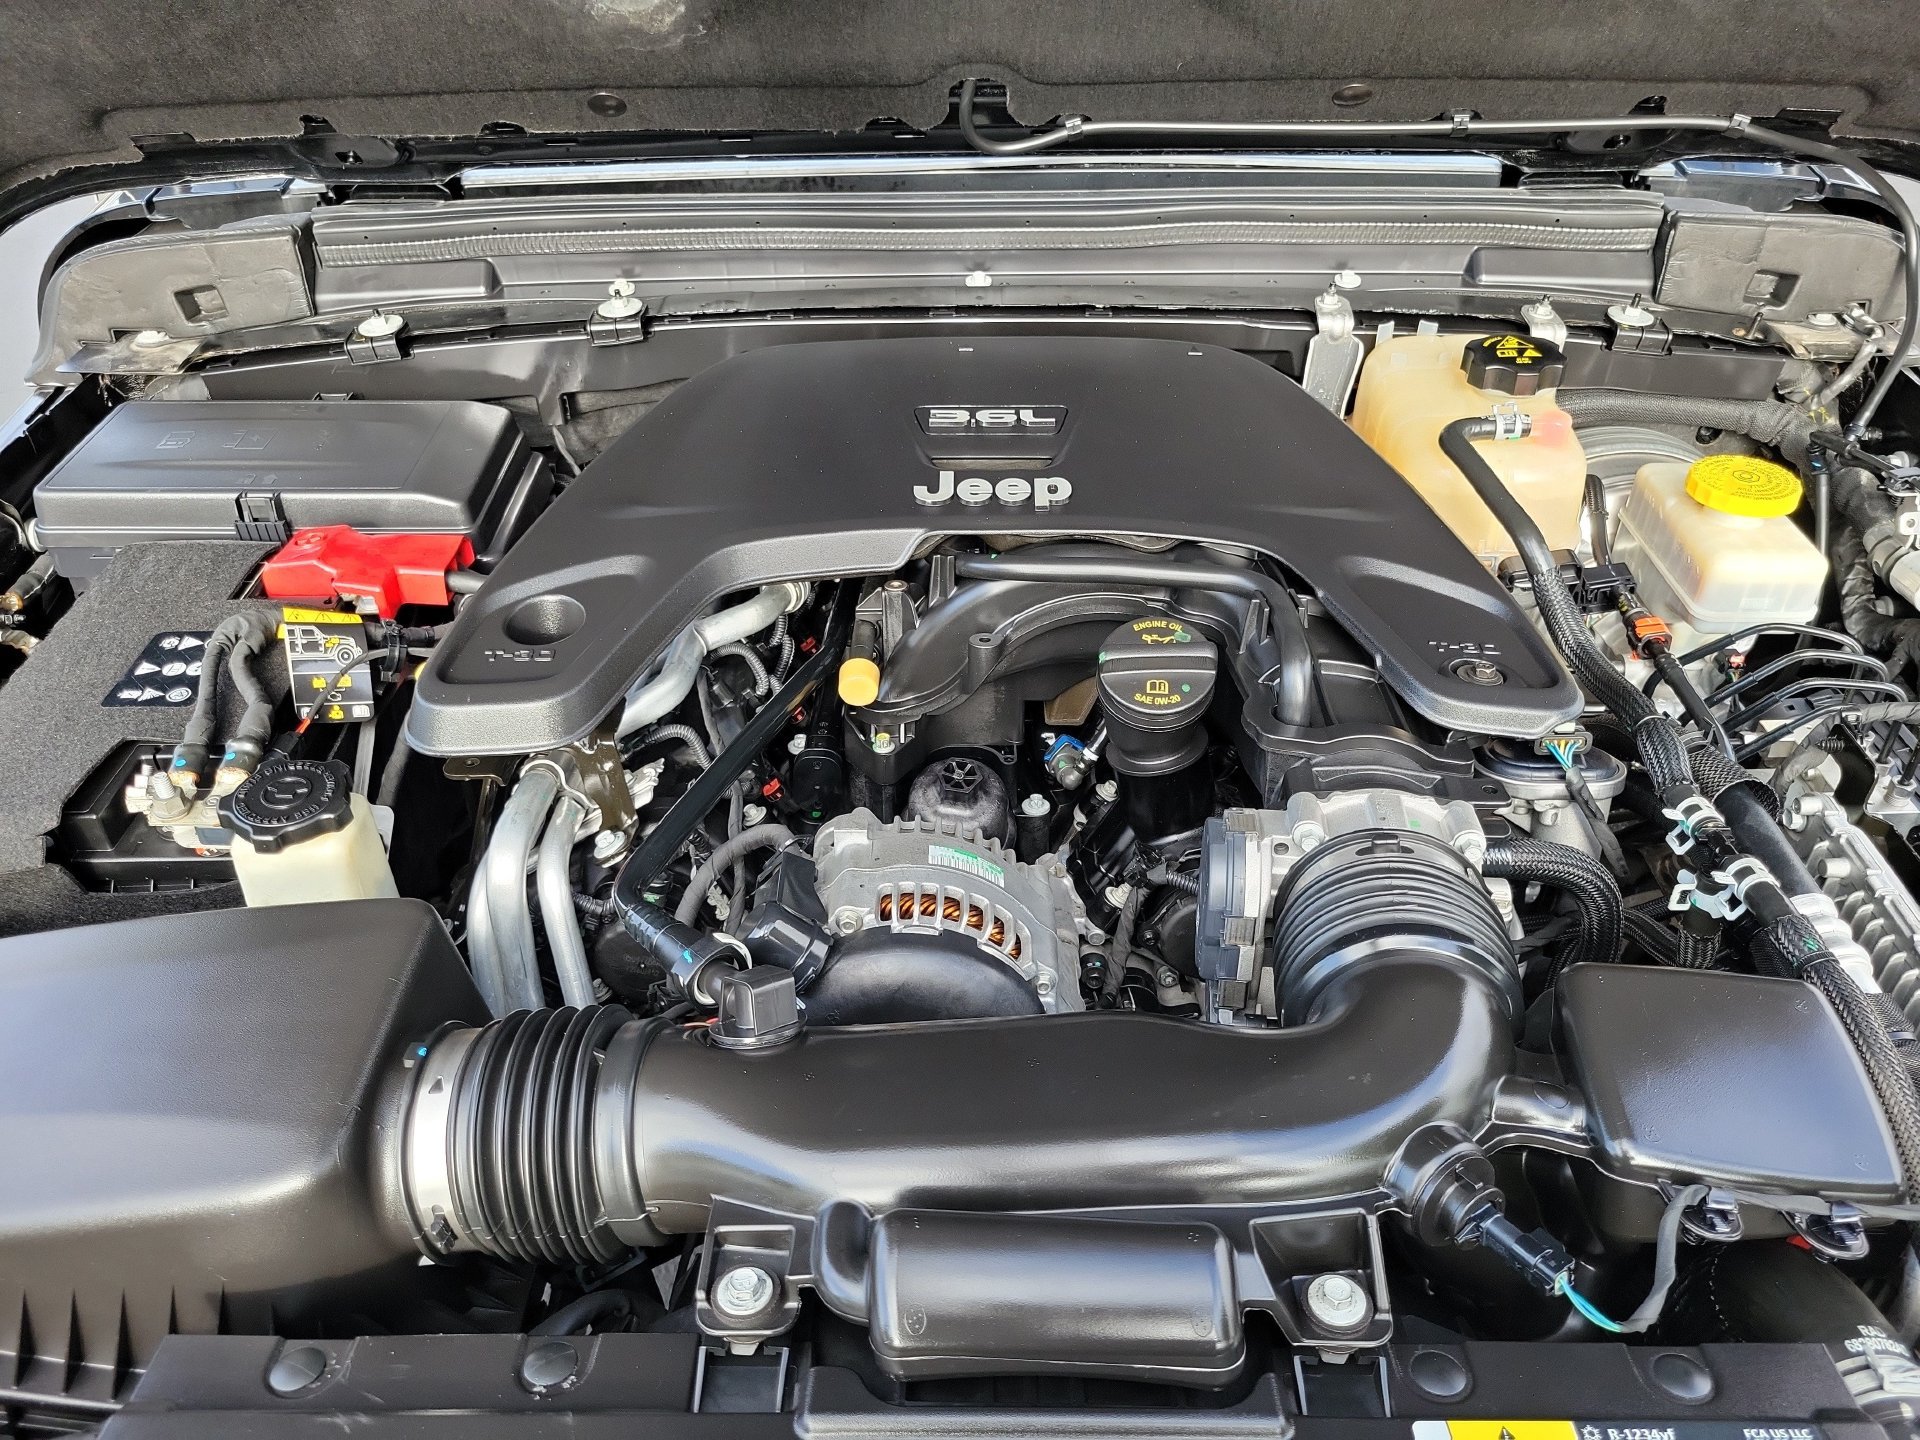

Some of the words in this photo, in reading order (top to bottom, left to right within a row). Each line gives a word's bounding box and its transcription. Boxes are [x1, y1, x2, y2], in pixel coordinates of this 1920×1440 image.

[929, 409, 1056, 427] 3.6L
[913, 470, 1073, 512] Jeep
[1132, 620, 1167, 632] ENGINE
[1168, 622, 1183, 633] OIL
[1133, 693, 1153, 705] SAE
[1154, 694, 1181, 705] 0W-20
[264, 761, 325, 776] STEERING
[1857, 1325, 1887, 1338] RAD
[1742, 1428, 1770, 1438] FCA
[1769, 1428, 1790, 1438] US
[1788, 1428, 1814, 1438] LLC
